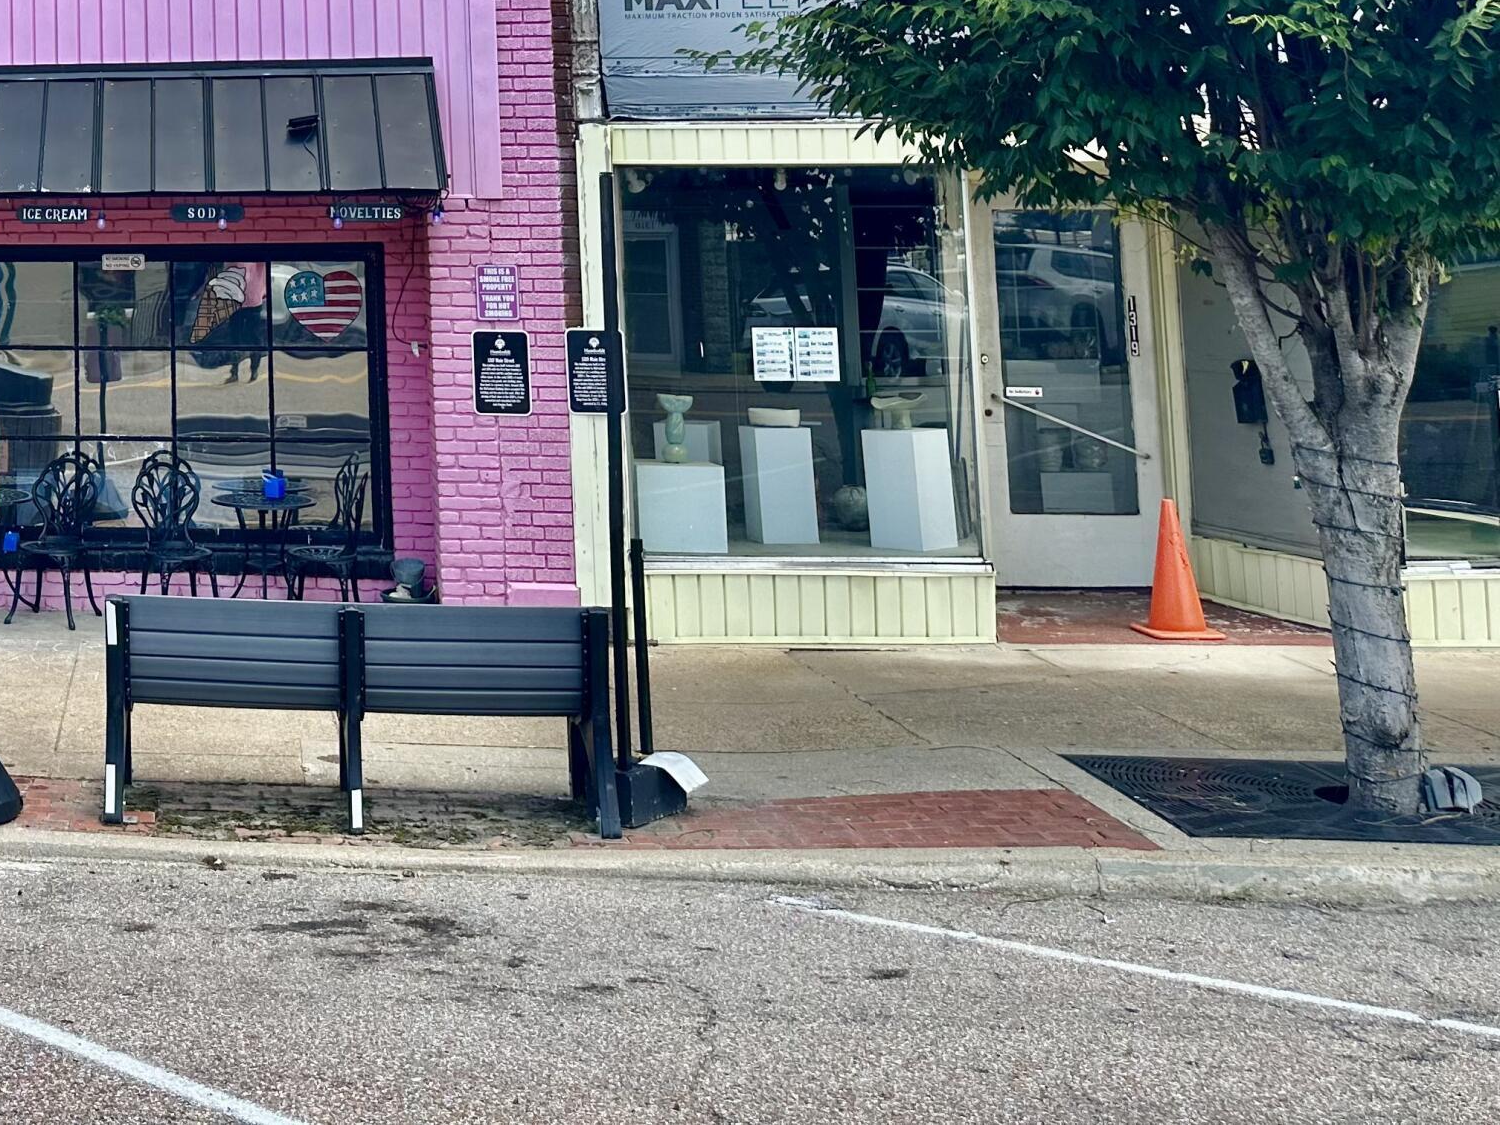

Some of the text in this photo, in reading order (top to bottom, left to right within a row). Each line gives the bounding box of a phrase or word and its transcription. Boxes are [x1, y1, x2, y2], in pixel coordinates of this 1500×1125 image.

[624, 12, 665, 20] MAXIMUM
[710, 11, 742, 19] PROVEN
[23, 208, 88, 222] ICE CREAM
[187, 207, 222, 219] SOD
[1129, 296, 1139, 356] 1319
